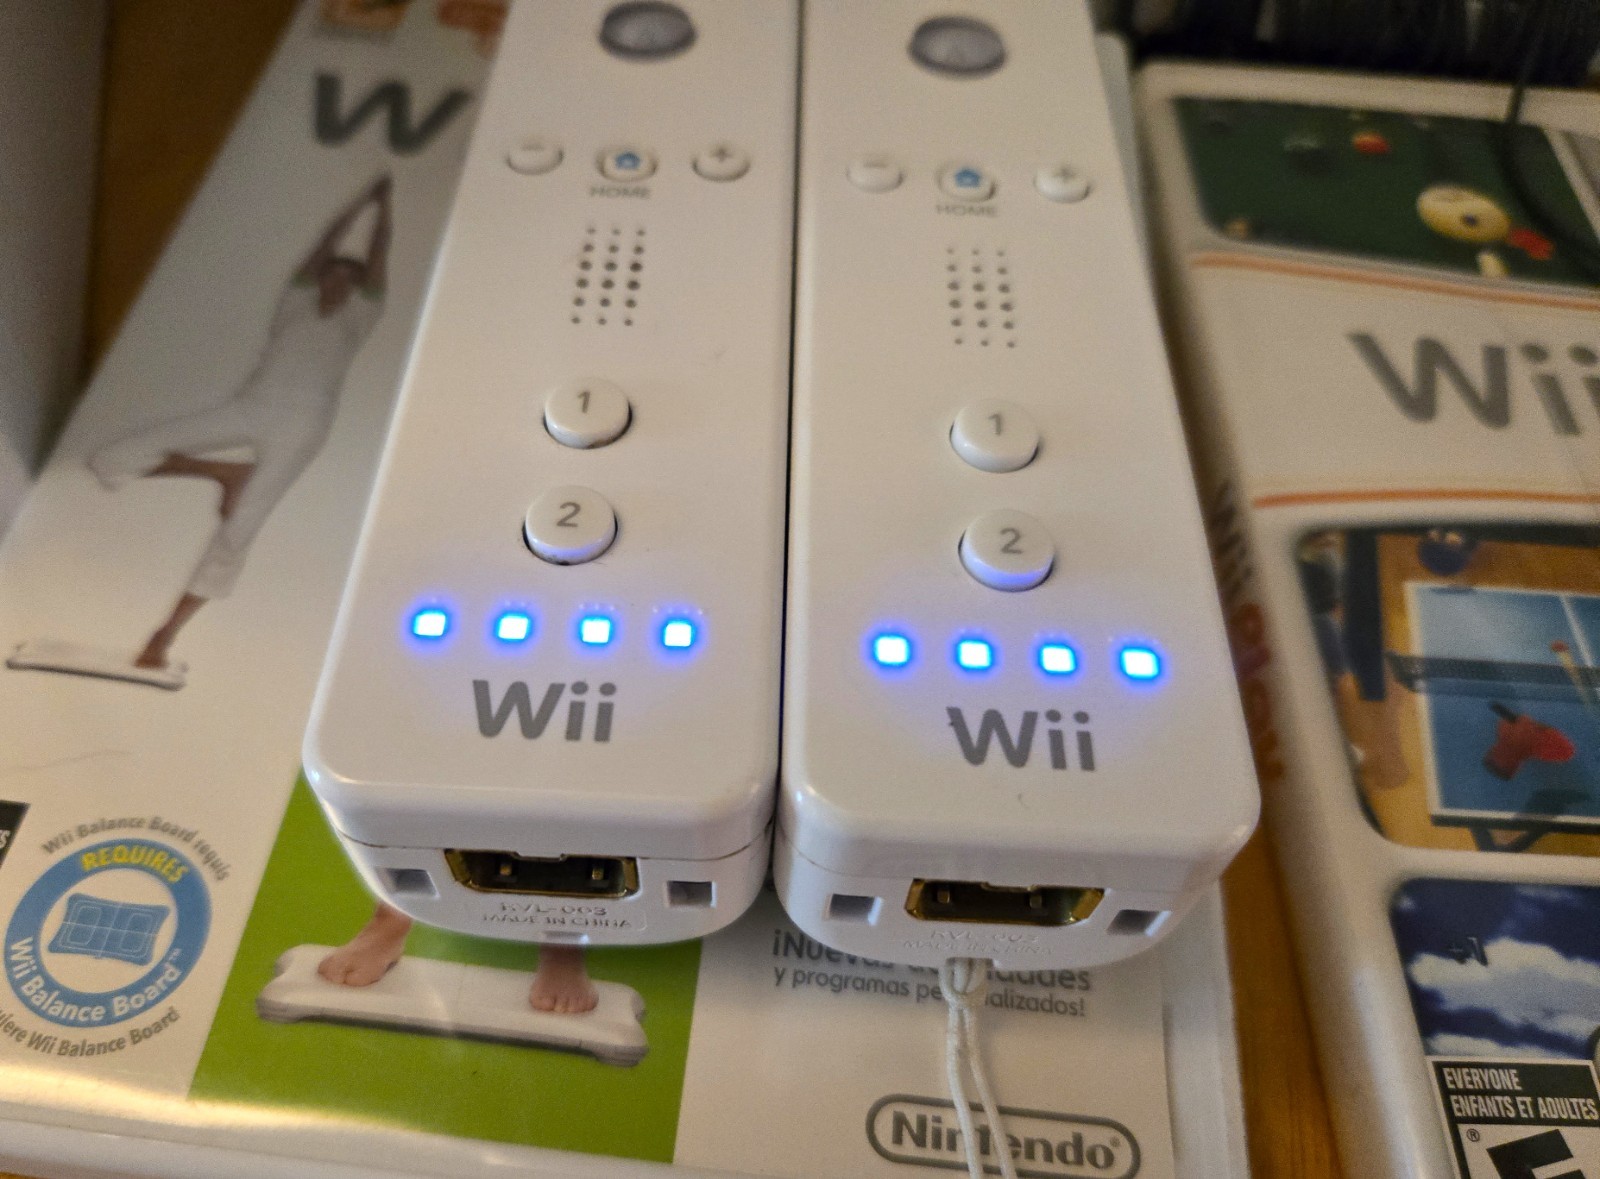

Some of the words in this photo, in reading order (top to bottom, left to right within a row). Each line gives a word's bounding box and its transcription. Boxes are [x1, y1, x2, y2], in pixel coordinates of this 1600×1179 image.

[577, 391, 591, 413] 1
[988, 413, 1003, 435] 1
[556, 501, 581, 527] 2
[1000, 527, 1023, 554] 2
[472, 680, 617, 742] Wii
[946, 706, 1095, 771] Wii
[42, 831, 74, 853] Wii
[77, 817, 146, 838] Balance
[149, 816, 199, 842] Board
[81, 845, 188, 883] REQUIRES
[11, 937, 37, 979] Wii
[21, 976, 106, 1021] Balance
[774, 967, 785, 987] y
[792, 969, 910, 997] programas
[27, 1031, 57, 1054] Wii
[57, 1037, 126, 1057] Balance
[129, 1006, 181, 1046] Board
[1443, 1067, 1522, 1090] EVERYONE
[1450, 1095, 1517, 1118] ENFANTS
[1516, 1096, 1534, 1119] ET
[1537, 1097, 1600, 1120] ADULTES
